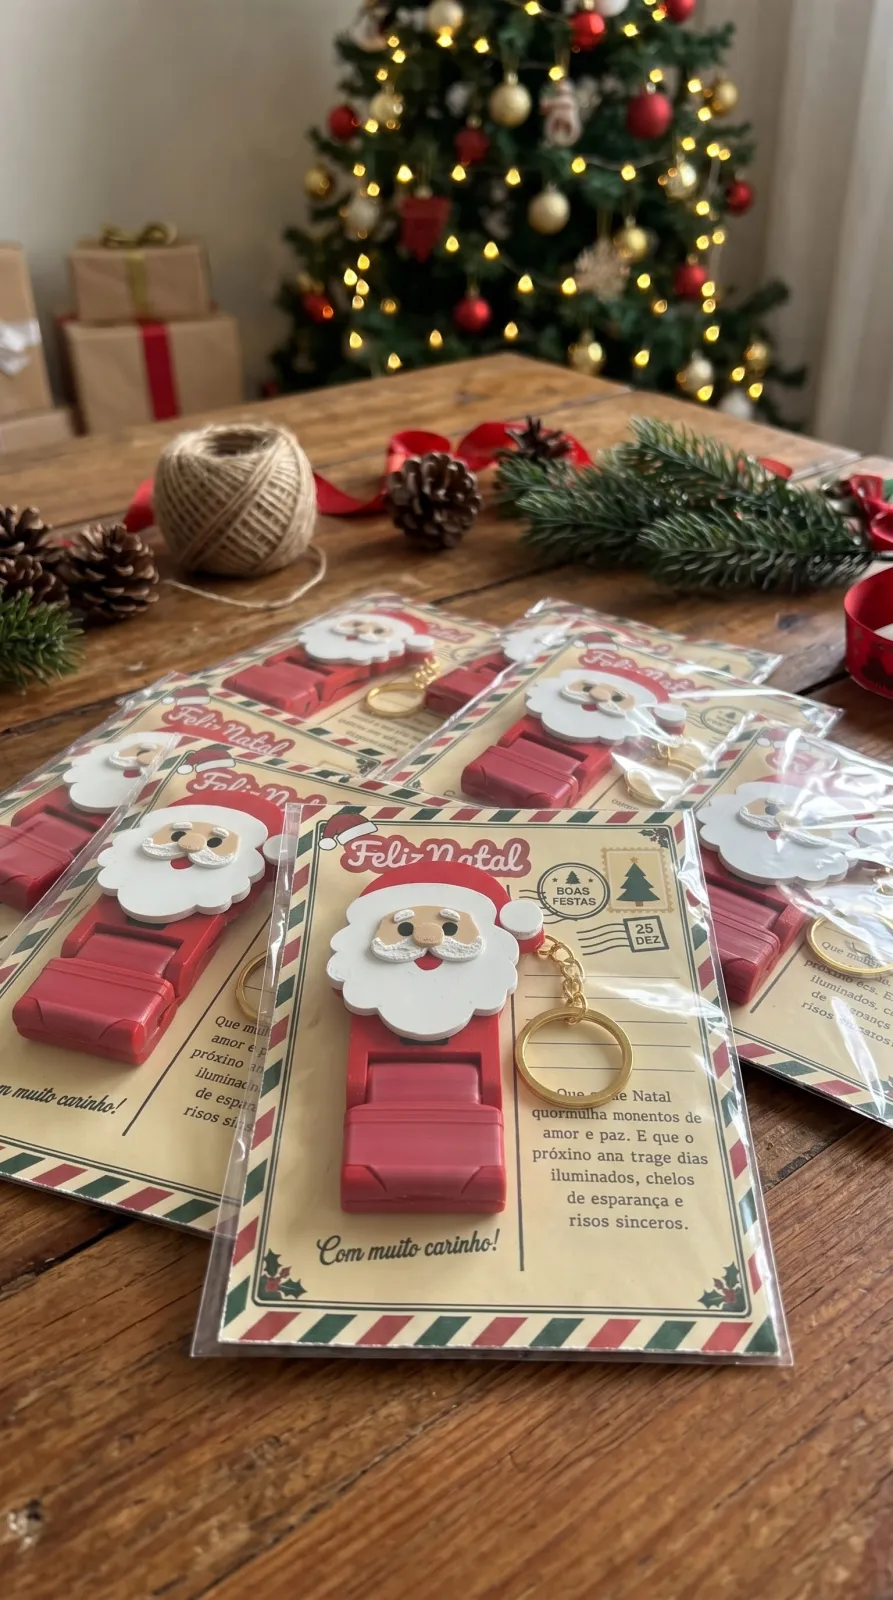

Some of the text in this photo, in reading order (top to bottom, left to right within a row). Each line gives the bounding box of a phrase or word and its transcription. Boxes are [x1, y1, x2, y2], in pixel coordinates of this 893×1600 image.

[347, 839, 523, 871] Feliz Natal
[556, 887, 590, 896] BOAS
[552, 897, 597, 906] FESTAS
[635, 923, 654, 934] 25
[635, 935, 661, 945] DEZ
[811, 990, 827, 1002] de
[801, 1001, 834, 1020] risos
[215, 1016, 240, 1030] Que
[211, 1034, 245, 1050] amor
[190, 1048, 244, 1069] próxino
[12, 1087, 57, 1104] muito
[56, 1095, 128, 1115] carinho!
[195, 1087, 212, 1101] de
[633, 1090, 672, 1103] Natal
[183, 1106, 220, 1123] risos
[685, 1112, 702, 1124] de
[543, 1128, 694, 1145] amor e paz. E que o
[631, 1151, 672, 1167] trage
[677, 1152, 709, 1165] dias
[550, 1168, 695, 1187] iluminados, chelos
[567, 1191, 684, 1210] de esparança e
[569, 1213, 689, 1230] risos sinceros.
[316, 1228, 500, 1266] Com muito carinho!
